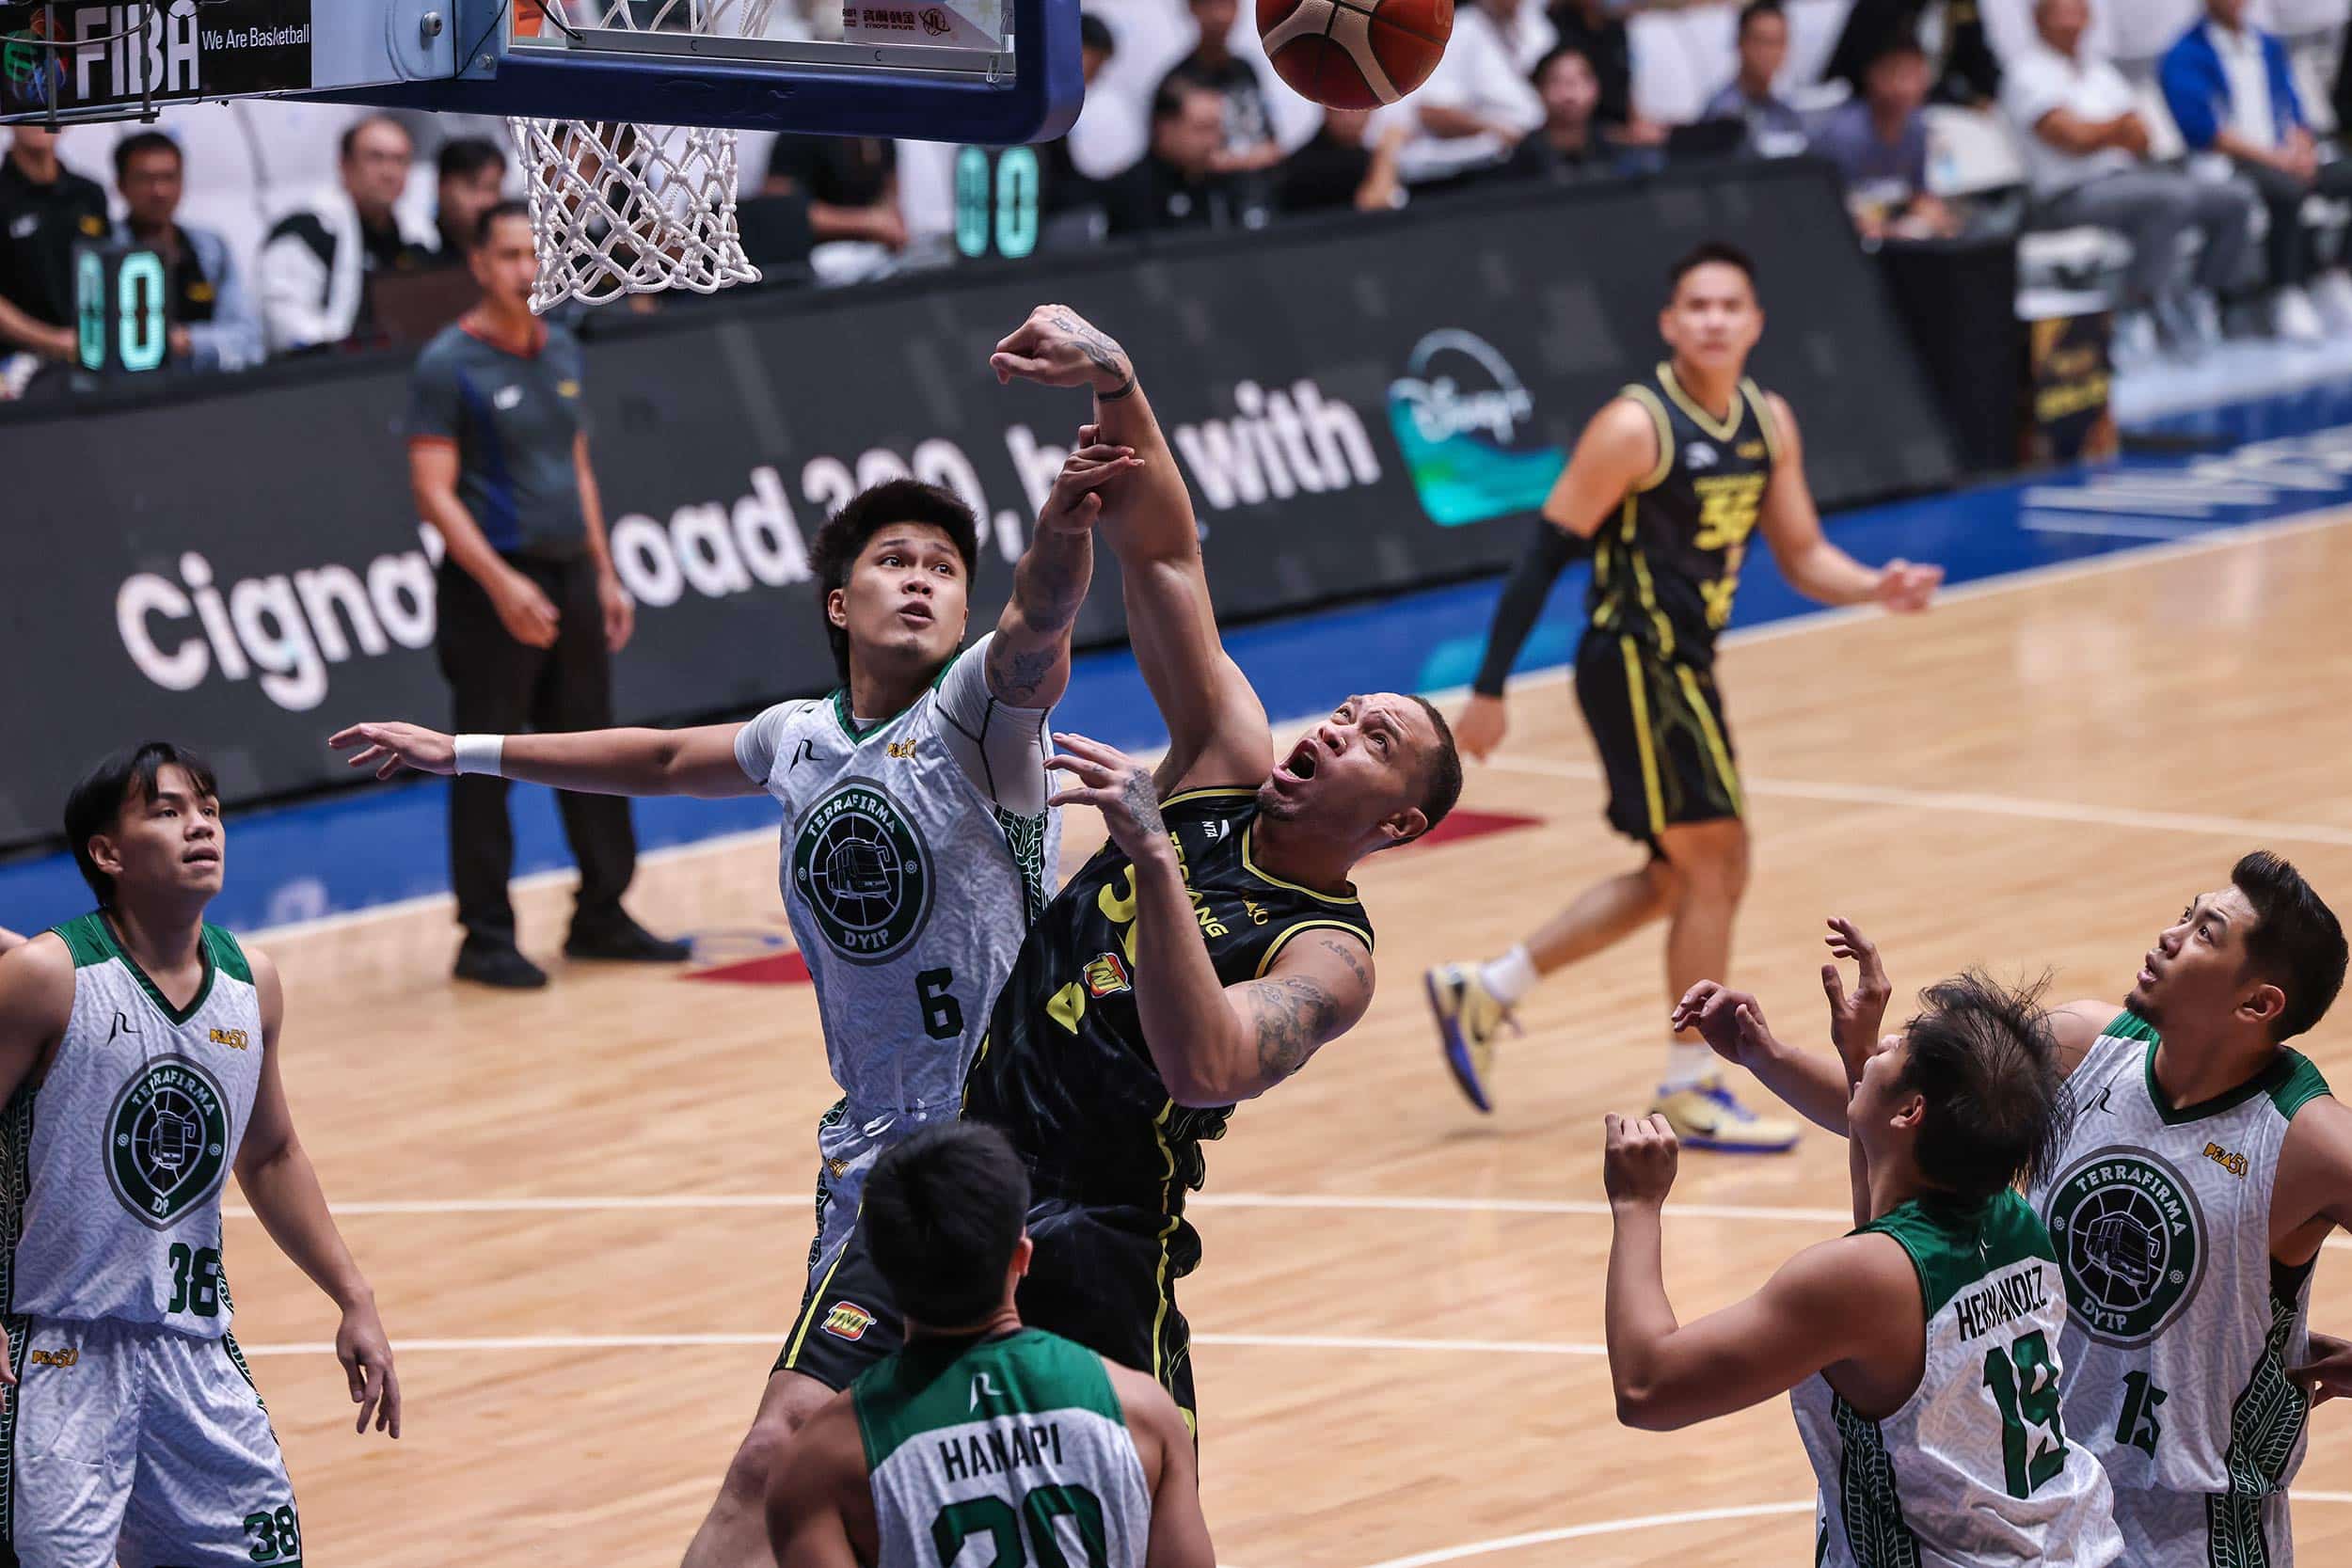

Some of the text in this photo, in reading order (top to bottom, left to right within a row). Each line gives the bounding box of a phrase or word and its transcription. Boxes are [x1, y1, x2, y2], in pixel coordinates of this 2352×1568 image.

[75, 0, 200, 100] FIBA
[201, 24, 310, 51] We Are Basketball
[117, 520, 447, 712] Cigna
[612, 467, 813, 608] oad
[1173, 379, 1382, 511] with
[806, 794, 898, 837] TERRAFIRMA
[843, 928, 890, 950] DYIP
[1085, 953, 1131, 993] TNT
[915, 967, 963, 1040] 6
[2075, 1164, 2187, 1237] TERRAFIRMA
[821, 1306, 877, 1334] TNT
[2080, 1296, 2127, 1332] DYIP
[1982, 1328, 2070, 1500] 19
[2115, 1370, 2168, 1460] 15
[938, 1423, 1063, 1483] HANAPI
[244, 1505, 297, 1561] 38
